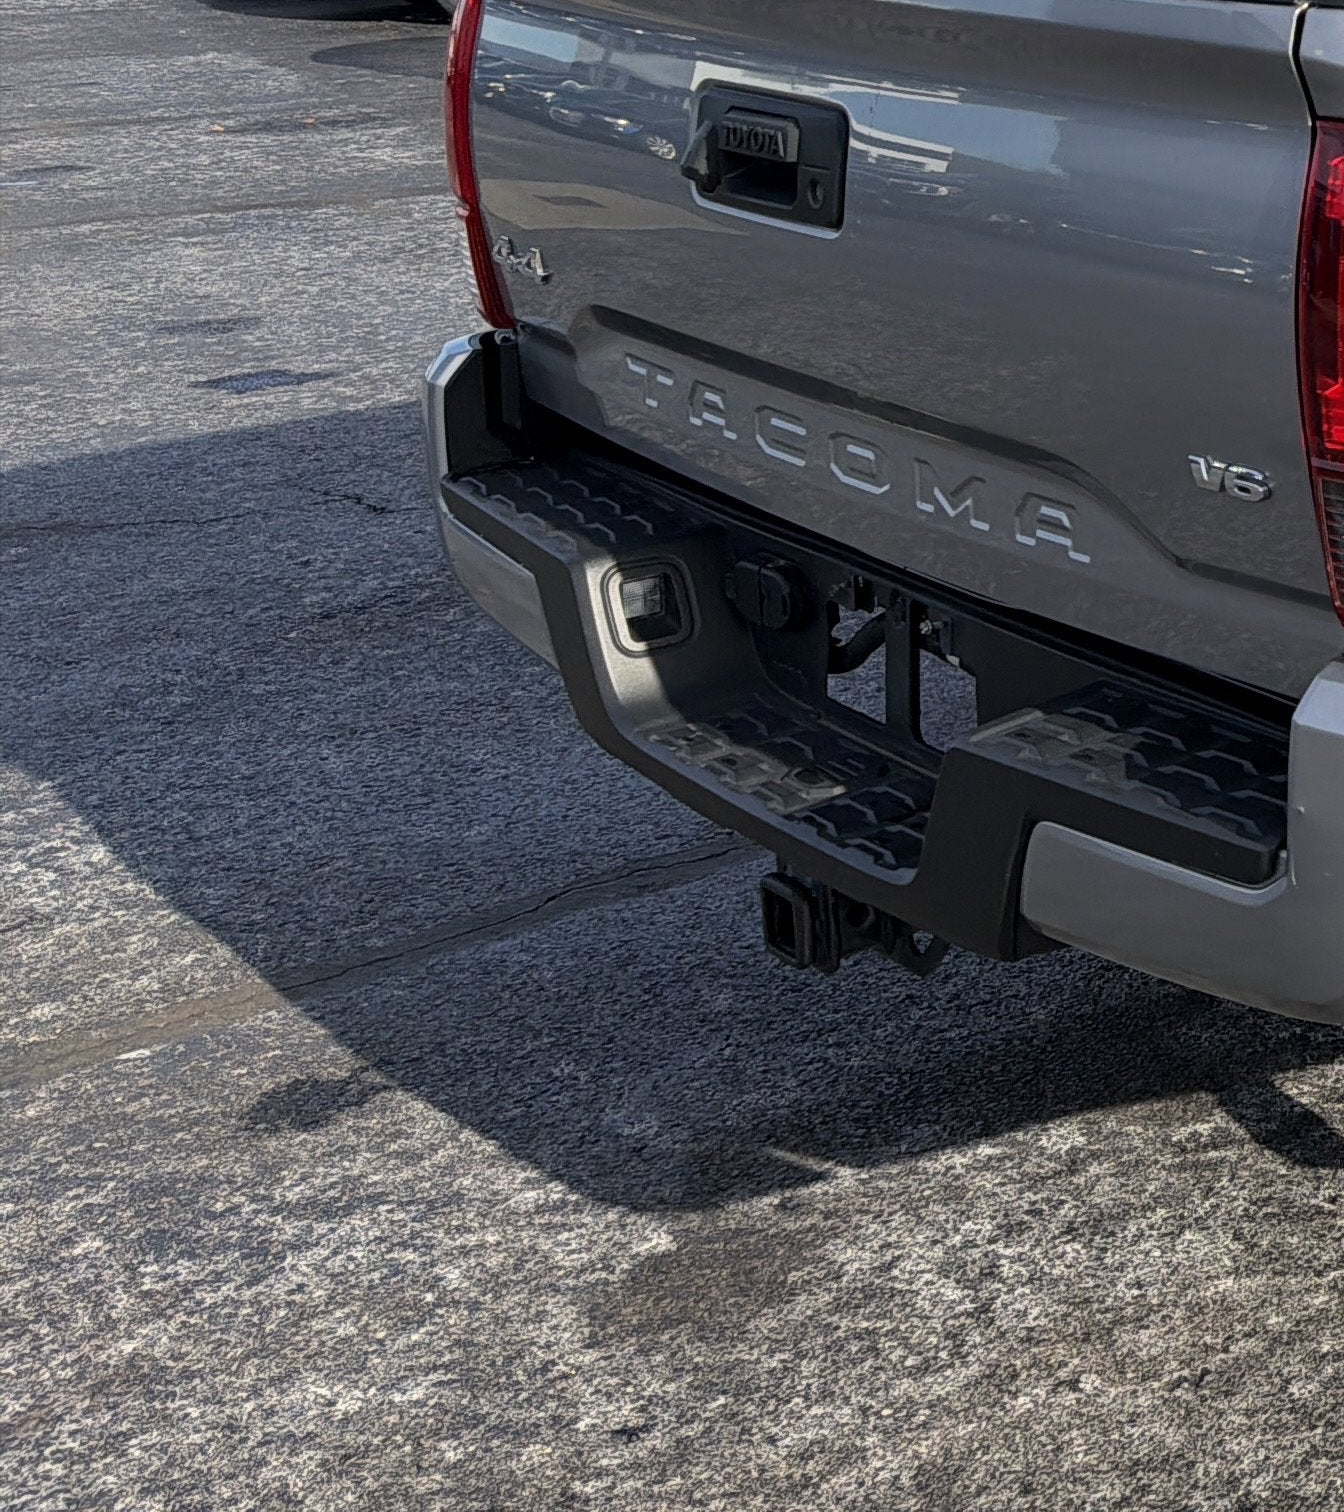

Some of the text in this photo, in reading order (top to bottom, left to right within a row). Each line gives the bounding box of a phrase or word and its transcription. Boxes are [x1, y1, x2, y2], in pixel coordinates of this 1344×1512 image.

[723, 121, 786, 159] TOYOTA
[623, 351, 1092, 565] TACOMA
[1186, 453, 1272, 503] V6
